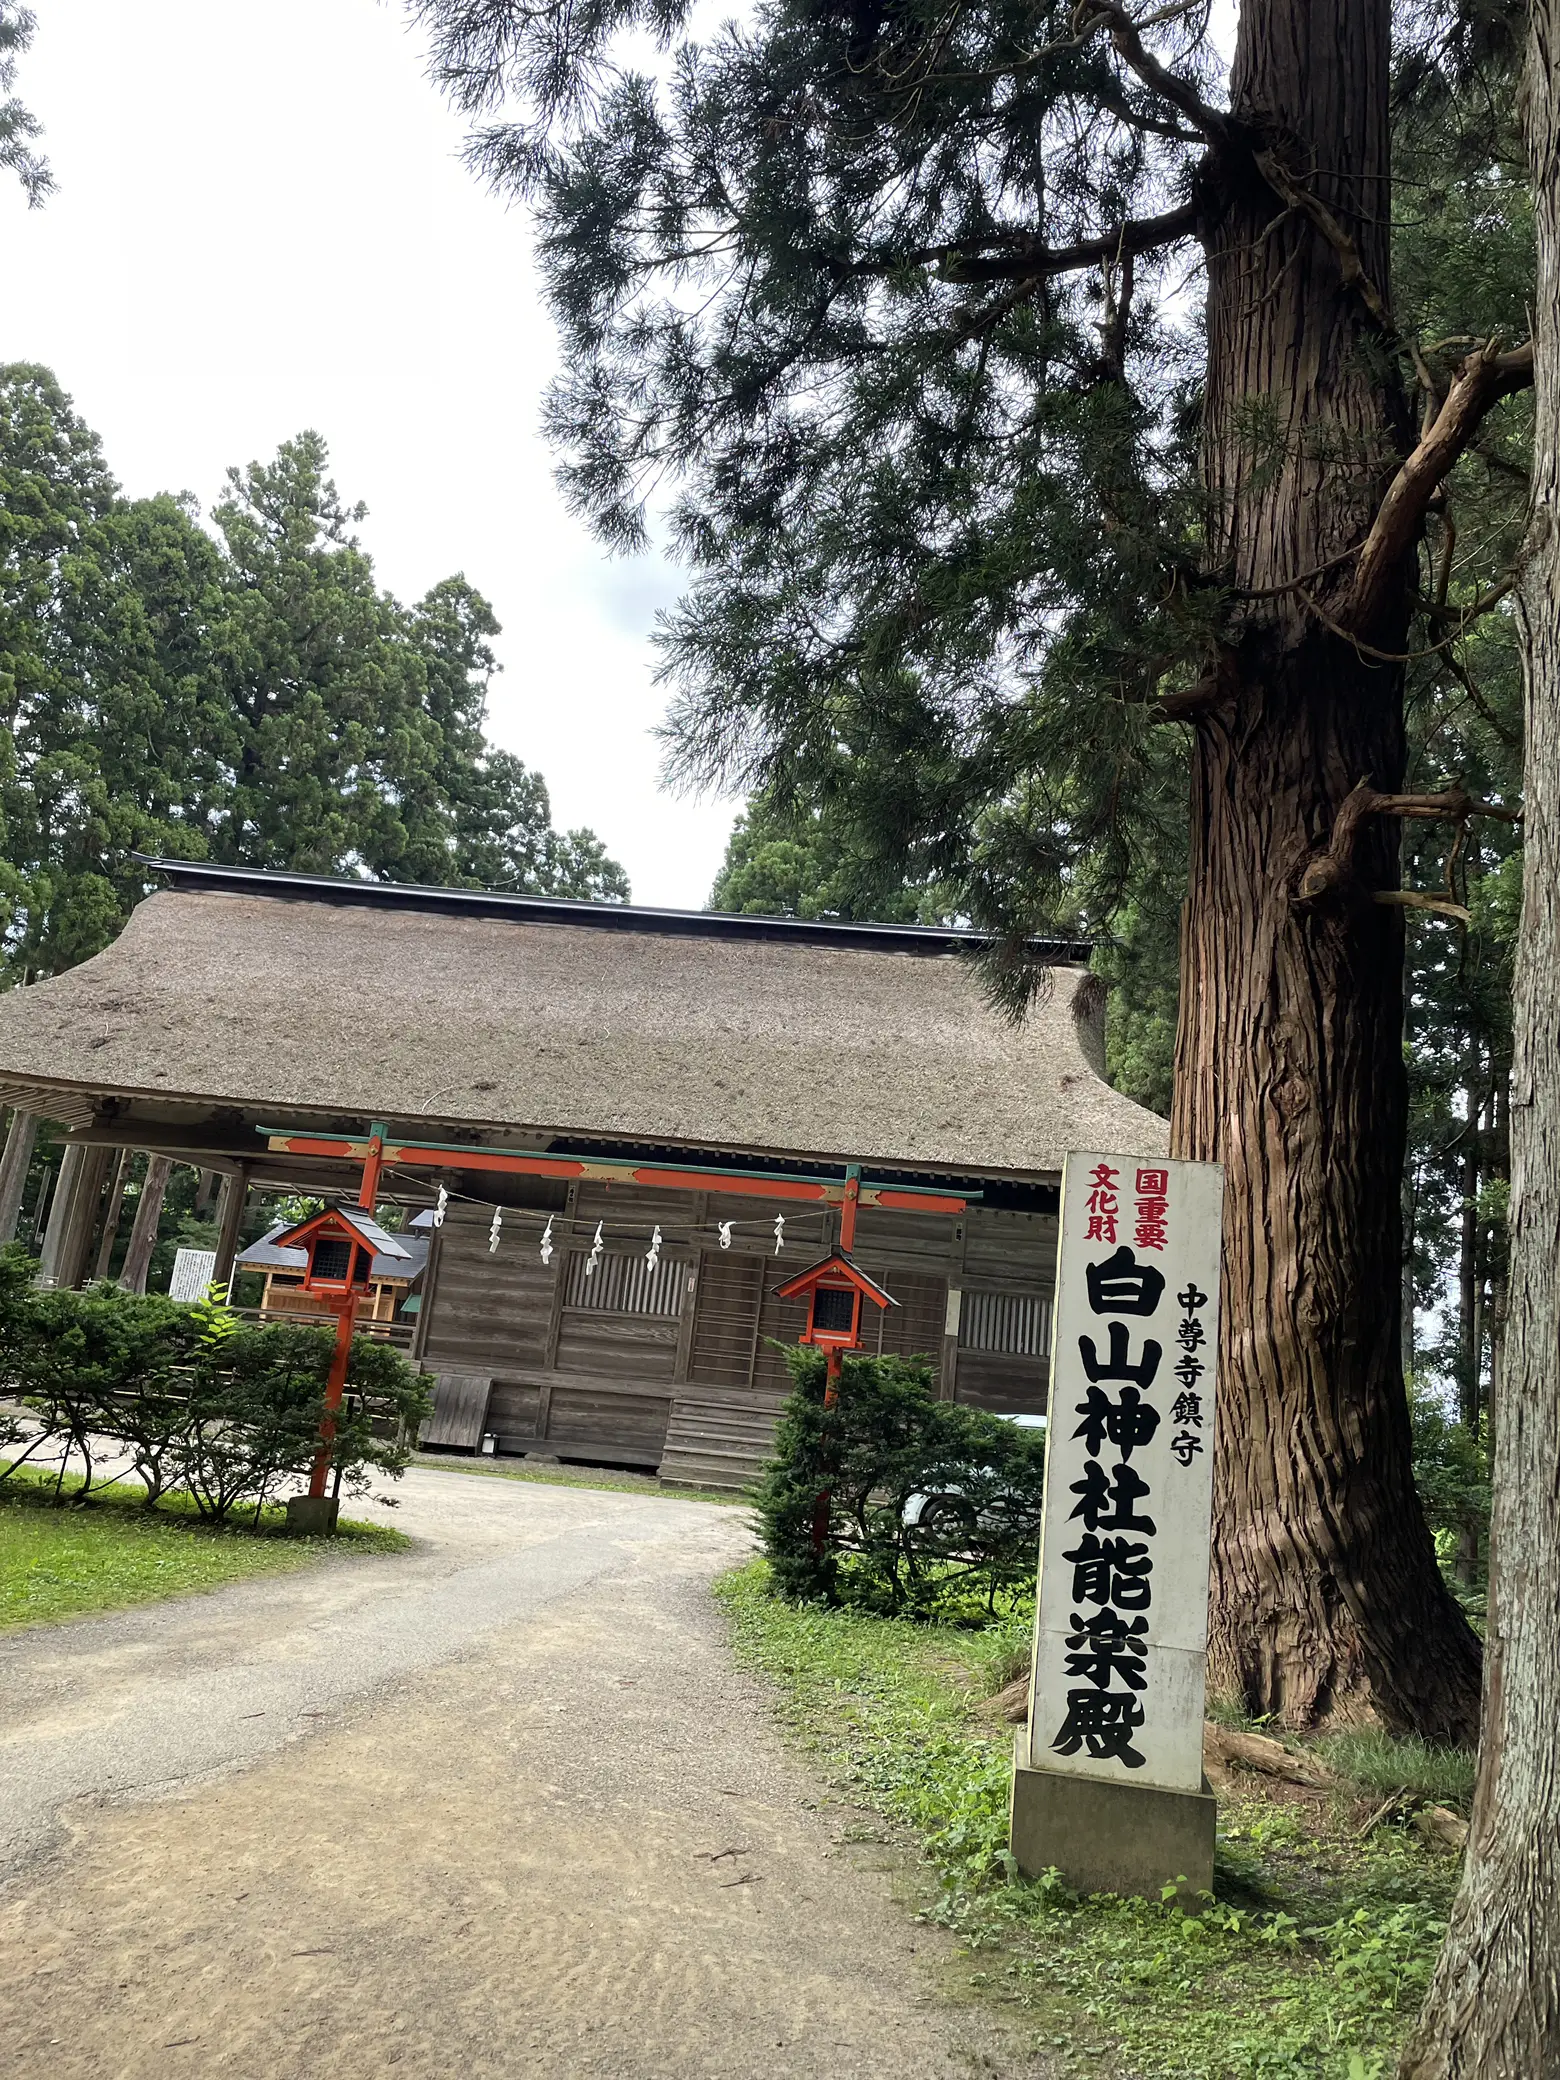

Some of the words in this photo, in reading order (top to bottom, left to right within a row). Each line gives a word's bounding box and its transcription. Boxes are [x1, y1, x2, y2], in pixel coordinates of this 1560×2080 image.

[1083, 1163, 1121, 1245] 文化財
[1133, 1168, 1170, 1251] 国重要
[1168, 1283, 1209, 1467] 中尊寺鎮守
[1048, 1245, 1166, 1769] 白山神社能楽殿
